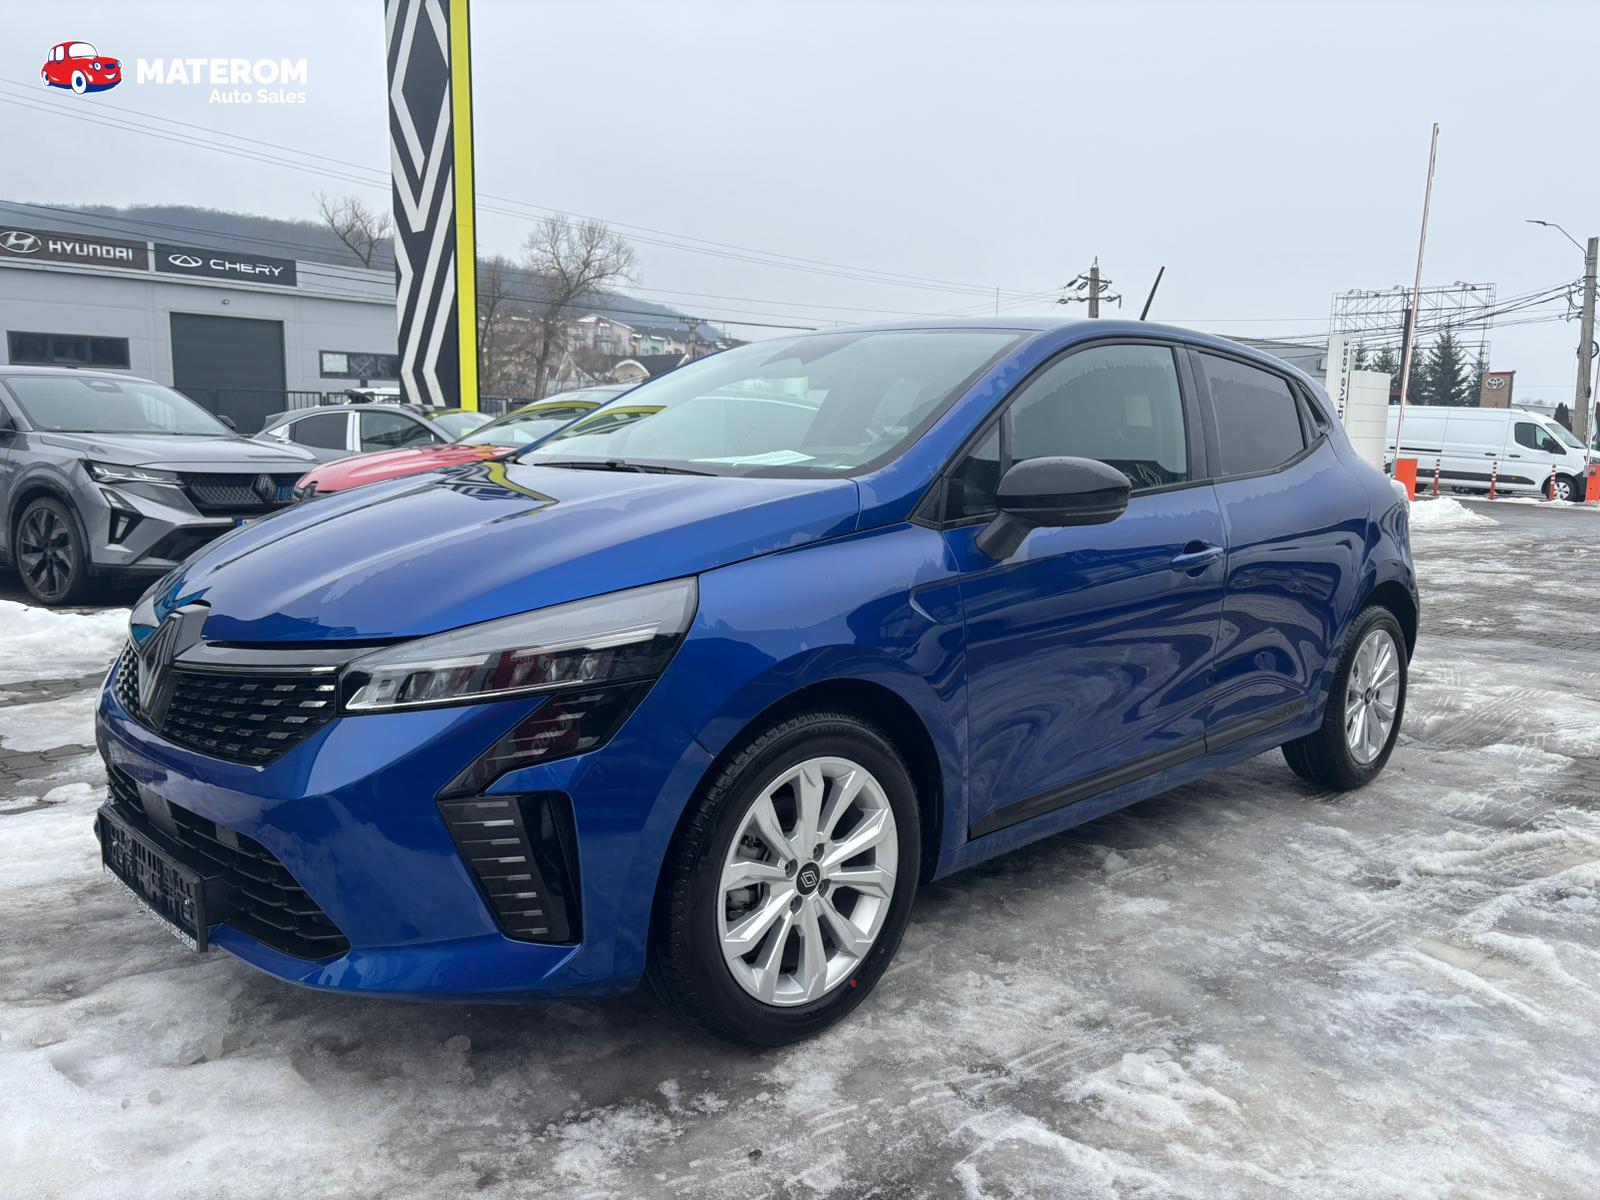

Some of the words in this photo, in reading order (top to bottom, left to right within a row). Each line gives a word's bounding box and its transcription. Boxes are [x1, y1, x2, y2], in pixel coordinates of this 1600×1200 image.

[48, 240, 133, 261] HYUNDAI
[210, 259, 285, 277] CHERY
[1337, 378, 1346, 419] drive
